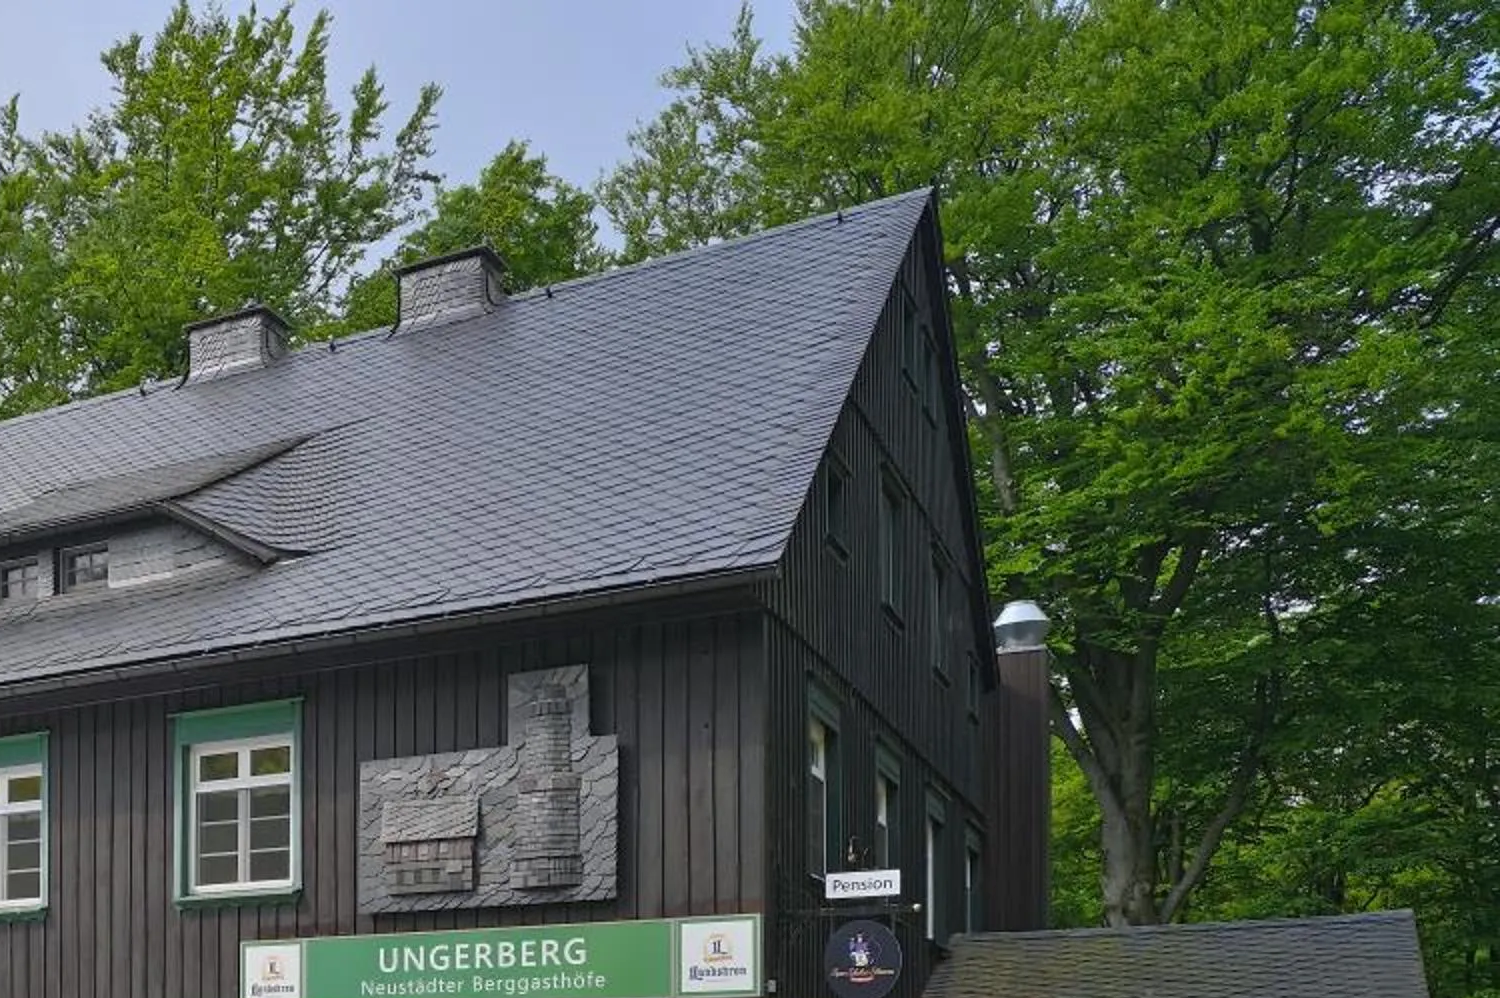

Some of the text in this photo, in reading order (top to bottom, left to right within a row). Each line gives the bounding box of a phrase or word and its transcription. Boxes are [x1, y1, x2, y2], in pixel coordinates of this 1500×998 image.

[833, 879, 893, 893] Pension
[379, 937, 587, 973] UNGERBERG
[361, 971, 605, 996] Neustädter Berggasthöfe
